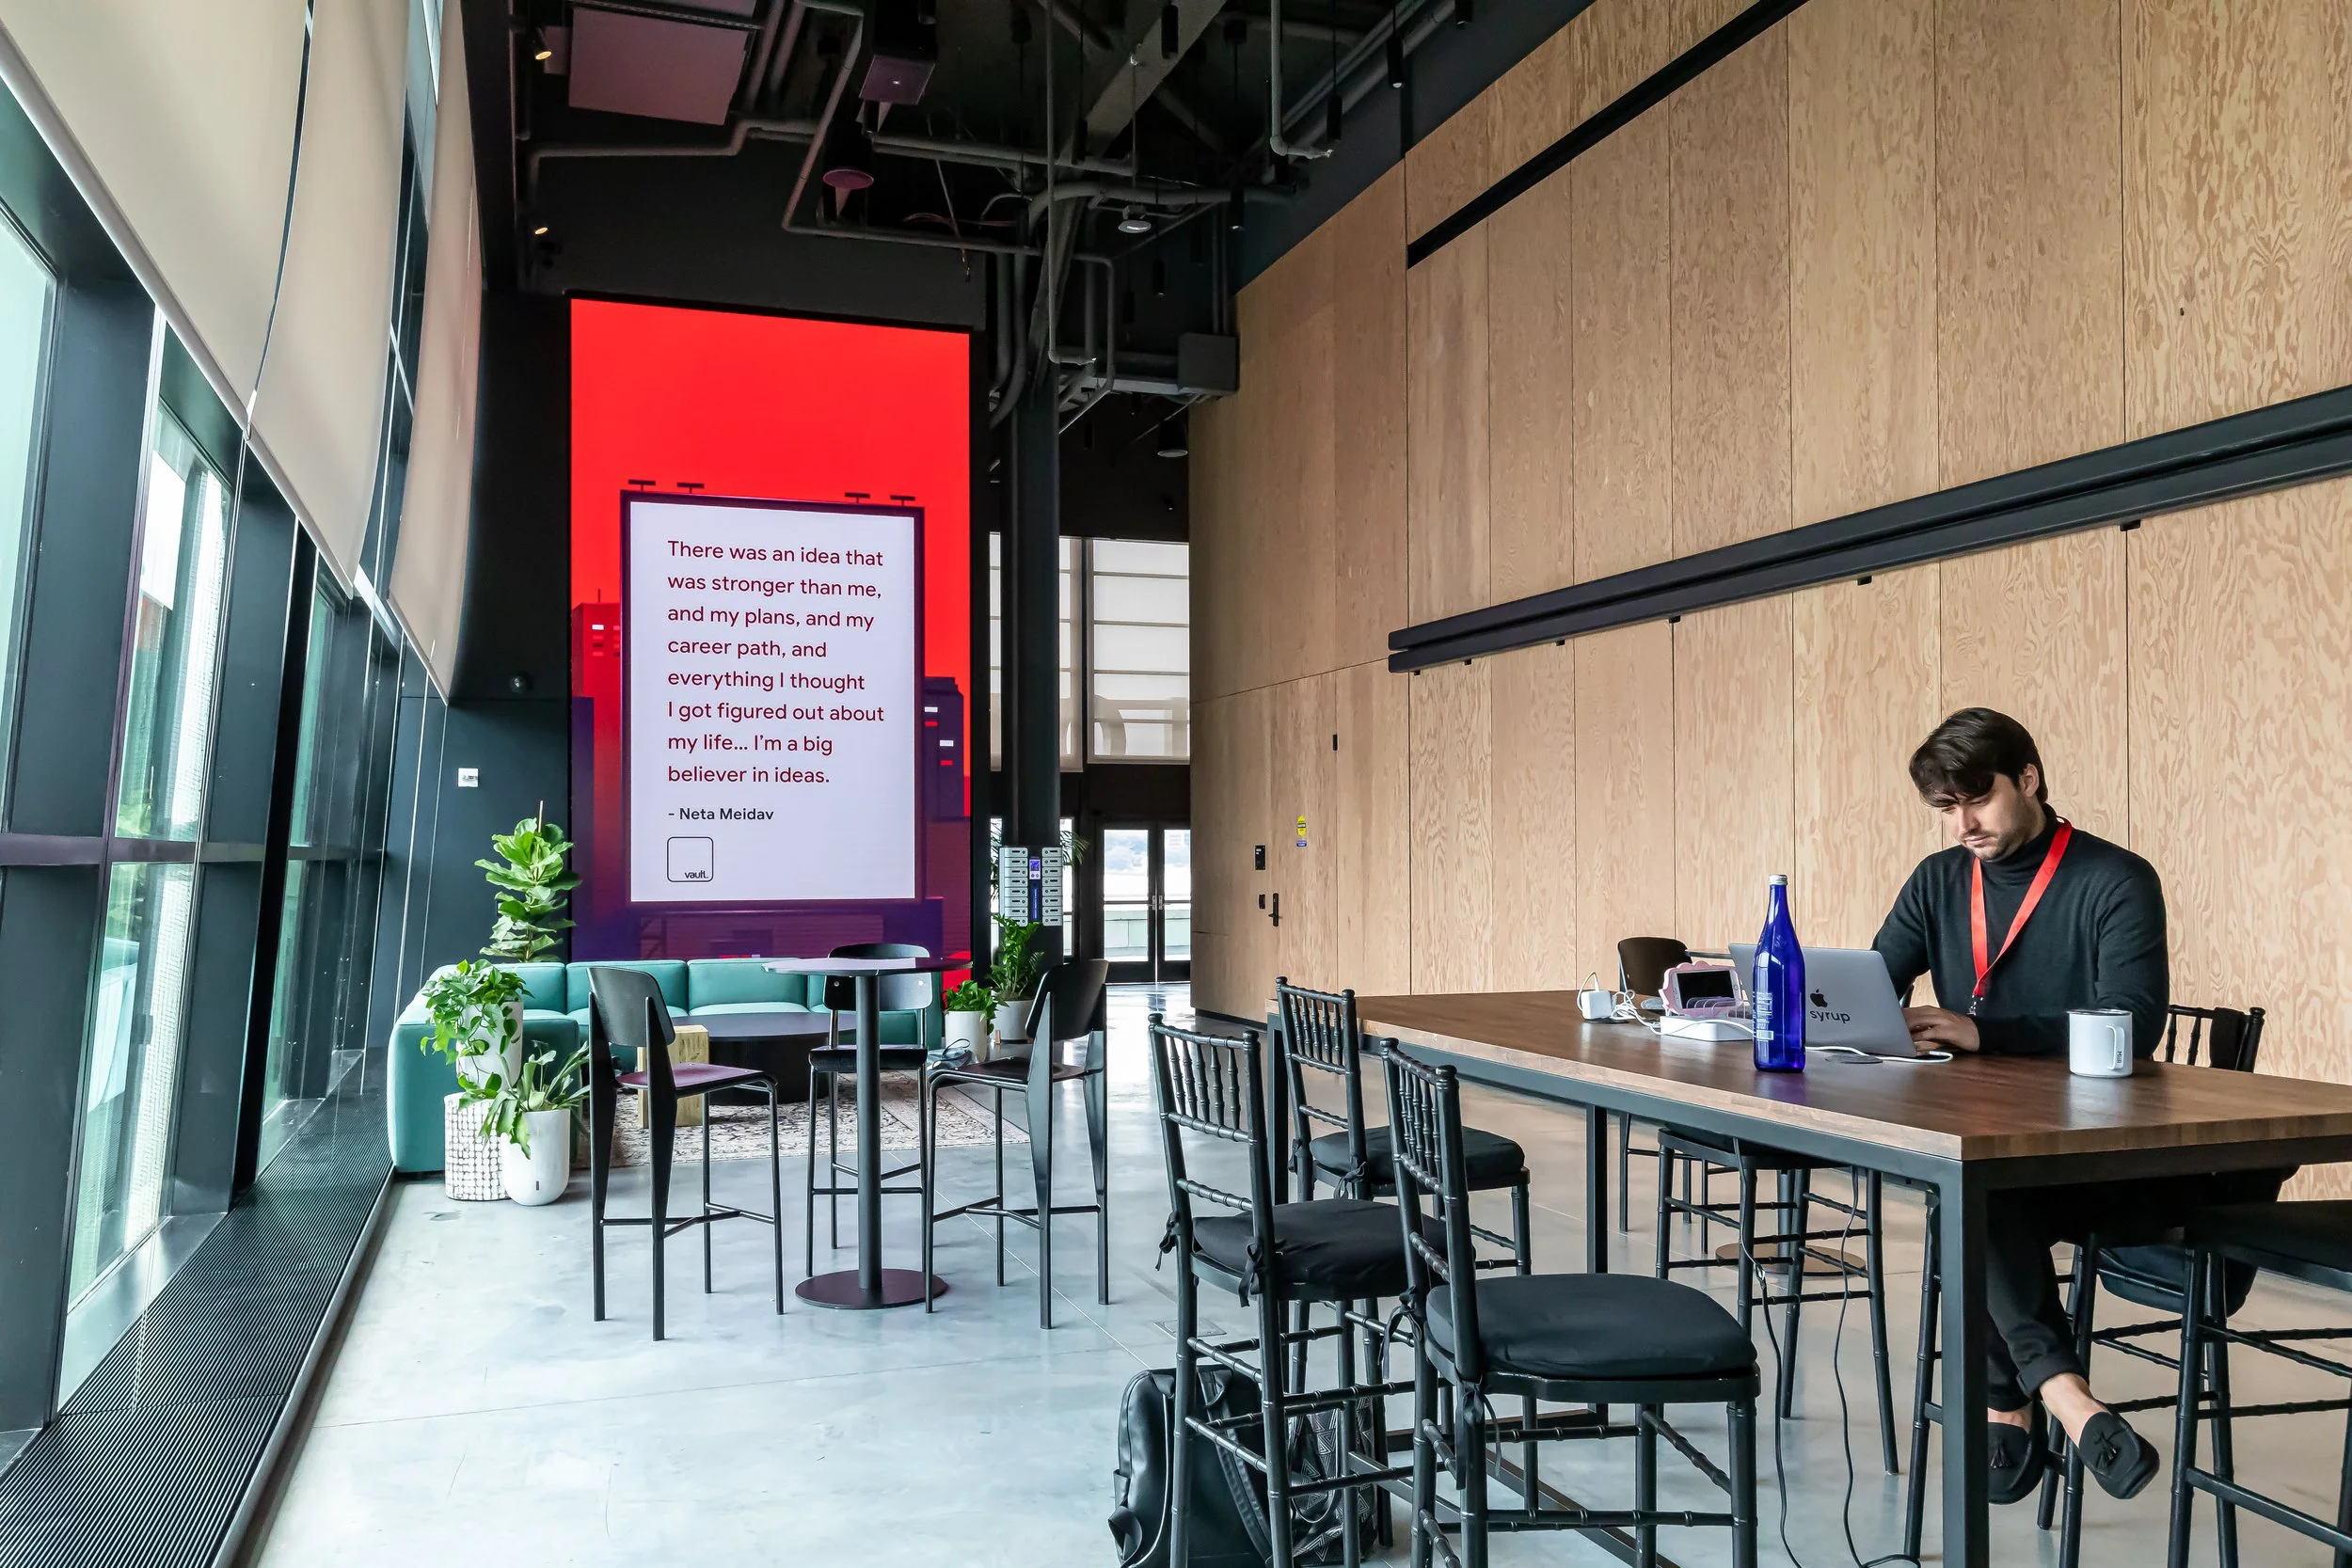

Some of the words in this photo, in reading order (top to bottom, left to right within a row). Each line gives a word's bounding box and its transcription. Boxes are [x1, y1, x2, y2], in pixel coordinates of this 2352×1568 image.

[667, 540, 724, 559] There
[728, 547, 768, 562] was
[771, 549, 795, 562] an
[801, 546, 840, 564] idea
[845, 549, 883, 566] that
[667, 577, 707, 590] was
[711, 576, 795, 597] stronger
[800, 578, 842, 595] than
[848, 584, 882, 599] me,
[667, 606, 704, 622] and
[710, 610, 739, 627] my
[745, 608, 801, 628] plans,
[805, 610, 841, 627] and
[846, 615, 875, 632] my
[667, 641, 732, 655] career
[737, 640, 787, 659] path,
[791, 641, 827, 657] and
[667, 670, 774, 692] everything
[780, 672, 784, 688] I
[789, 673, 866, 694] thought
[668, 701, 673, 718] I
[678, 703, 712, 722] got
[716, 702, 787, 723] figured
[792, 705, 824, 721] out
[829, 705, 884, 722] about
[668, 736, 698, 754] my
[704, 734, 748, 751] life...
[787, 738, 798, 752] a
[803, 736, 833, 756] big
[668, 765, 748, 783] believer
[753, 766, 769, 783] in
[774, 766, 830, 784] ideas.
[679, 807, 715, 820] Neta
[720, 807, 774, 820] Meidav
[1809, 1010, 1851, 1024] syrup
